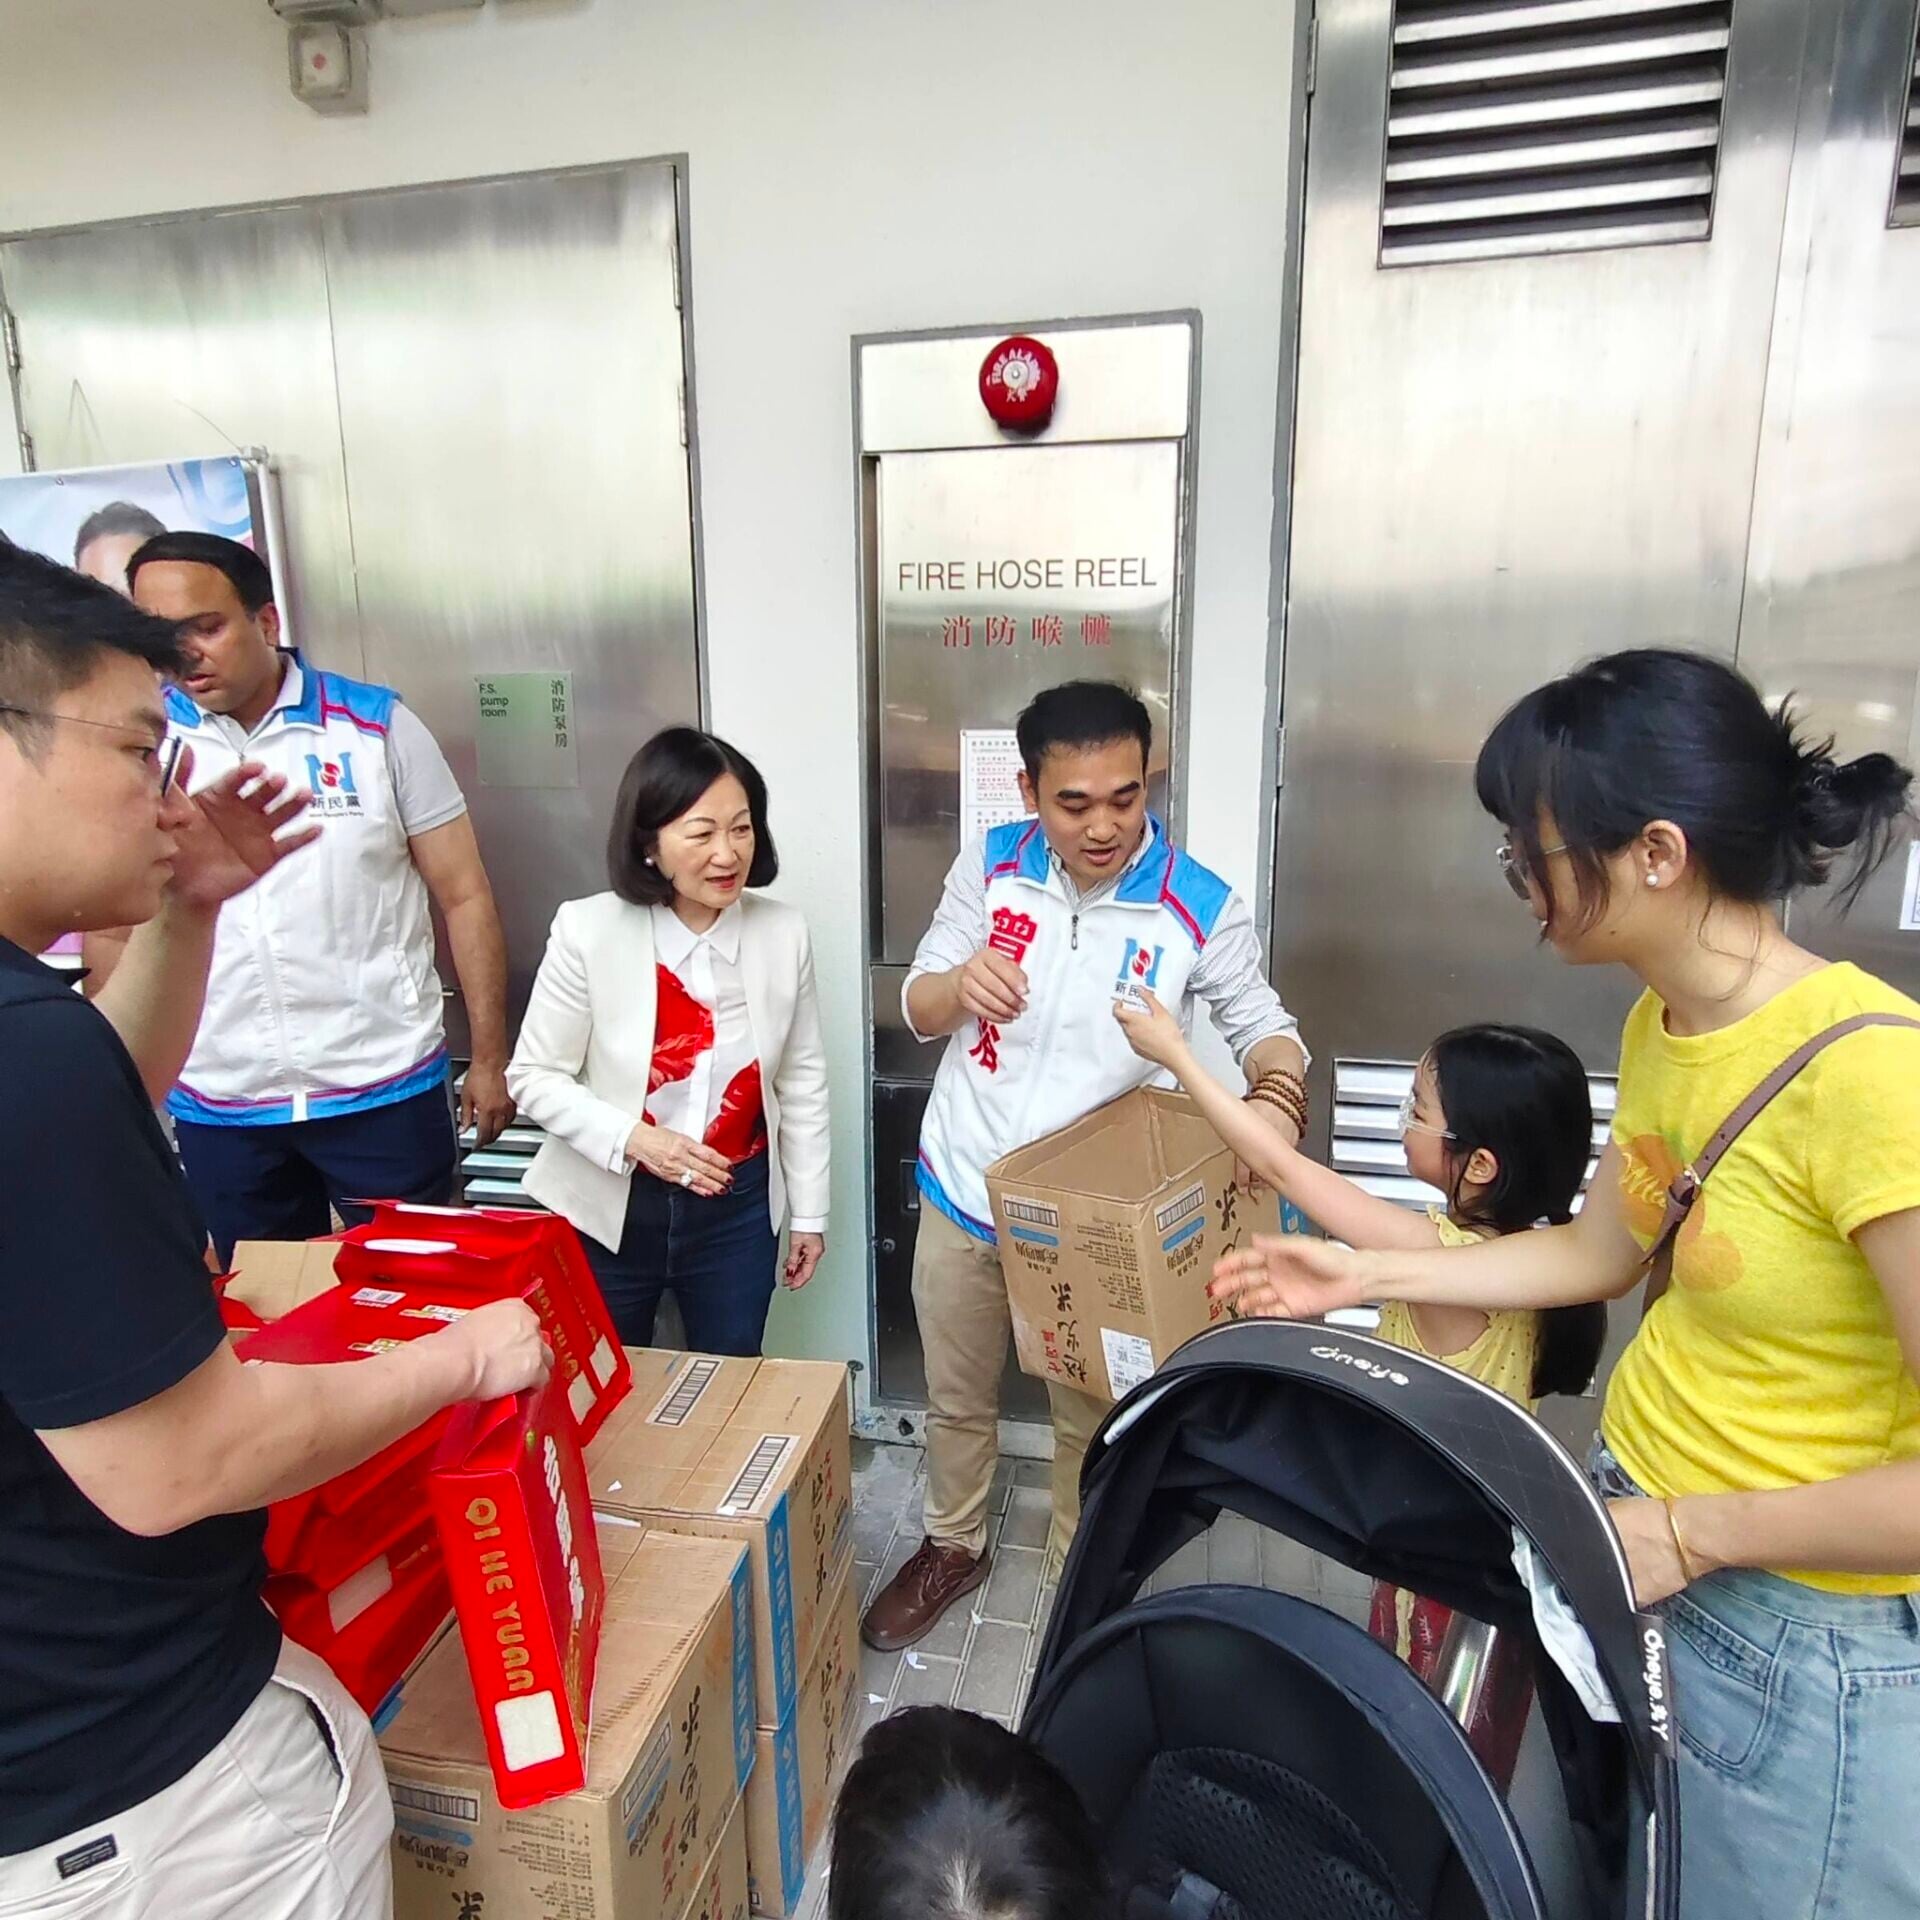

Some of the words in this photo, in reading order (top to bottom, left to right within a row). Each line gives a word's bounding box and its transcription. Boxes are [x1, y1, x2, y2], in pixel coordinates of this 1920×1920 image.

[899, 562, 965, 591] FIRE
[976, 559, 1063, 590] HOSE
[1075, 557, 1157, 587] REEL
[480, 697, 509, 707] pump
[481, 709, 507, 718] room
[465, 1497, 501, 1541] QI
[480, 1550, 513, 1595] HE
[492, 1601, 535, 1692] YUAN
